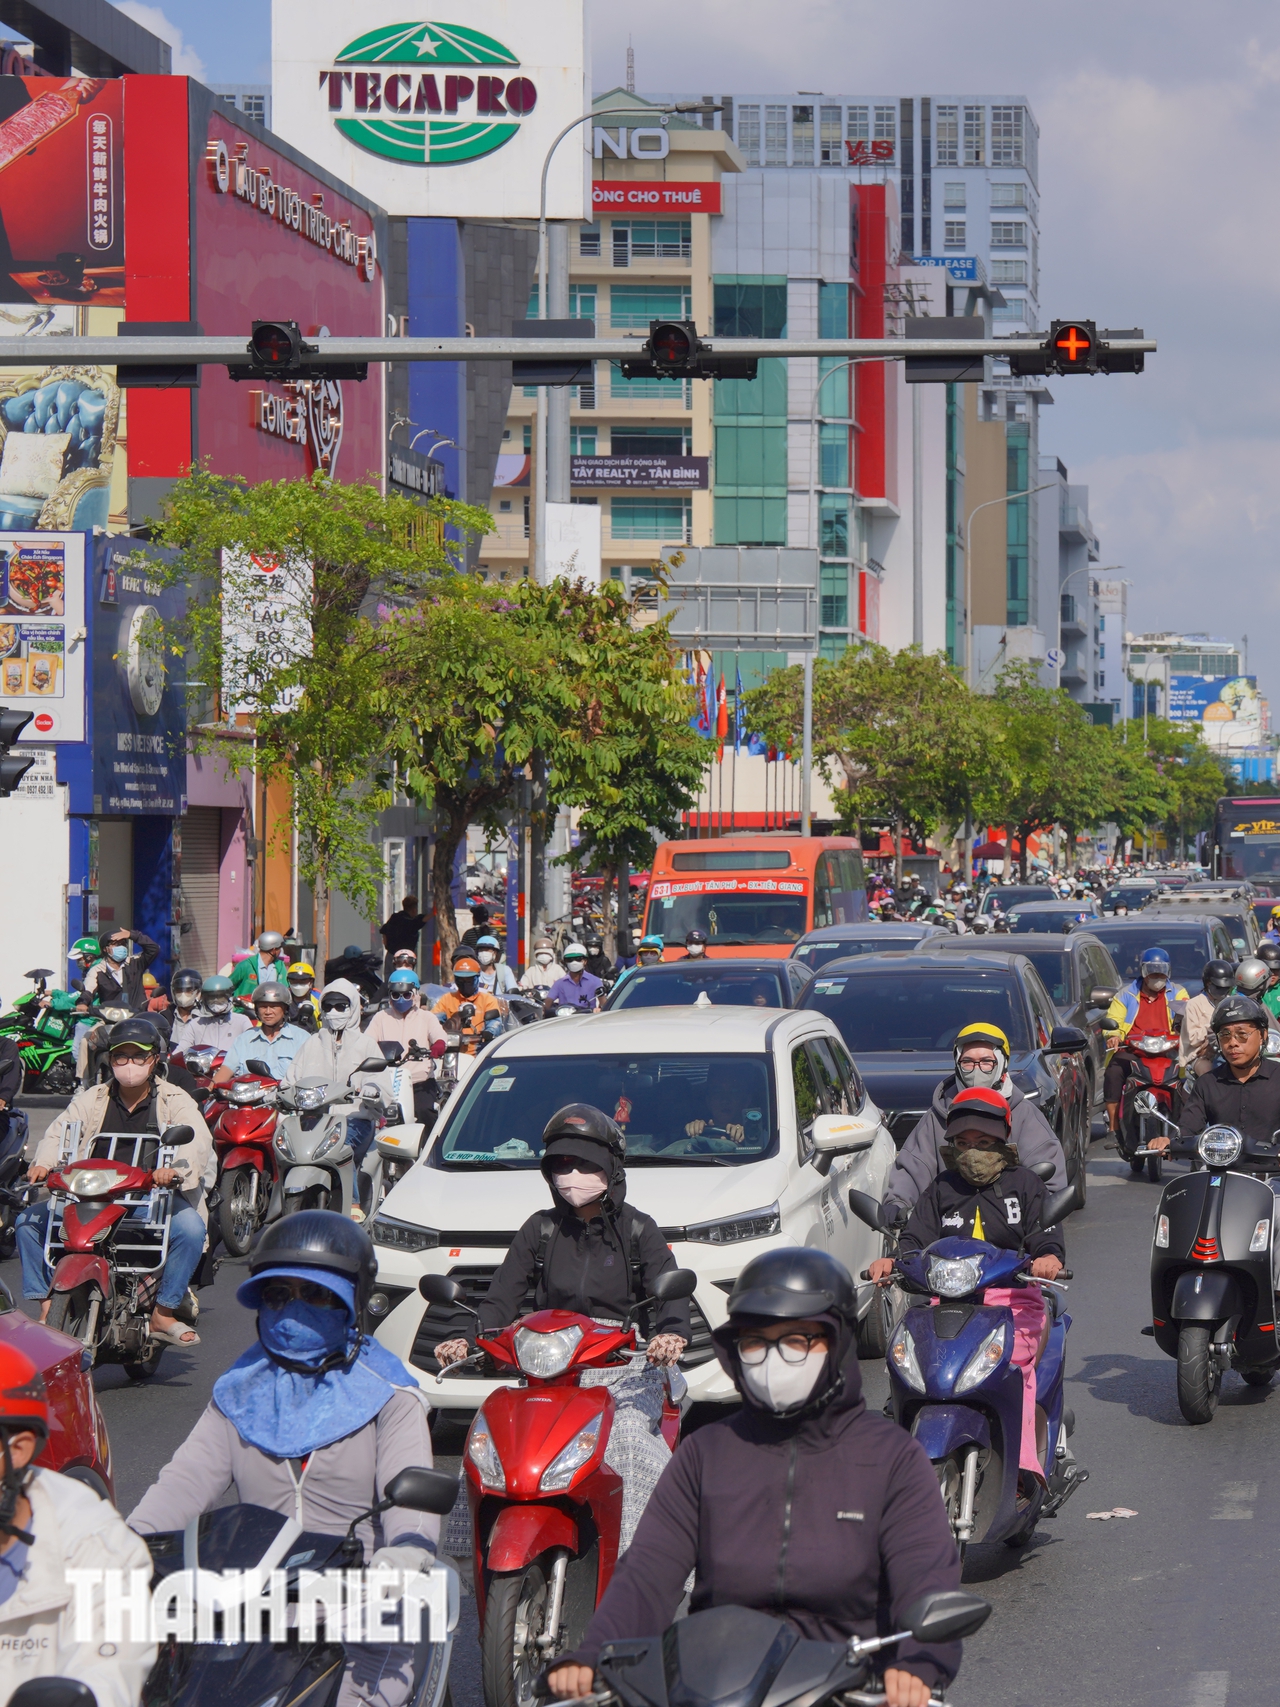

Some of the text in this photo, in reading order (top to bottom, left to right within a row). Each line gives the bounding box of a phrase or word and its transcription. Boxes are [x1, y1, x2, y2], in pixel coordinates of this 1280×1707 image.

[319, 71, 538, 114] TECAPRO
[594, 126, 670, 159] NO
[845, 140, 894, 162] VUS
[592, 187, 702, 204] ÒNG CHO THUÊ
[938, 259, 973, 269] LEASE
[261, 390, 293, 440] LONG
[572, 466, 700, 479] TÂY REALTY TÂN BÌNH
[1251, 820, 1276, 831] VIP
[778, 880, 803, 892] GIANG
